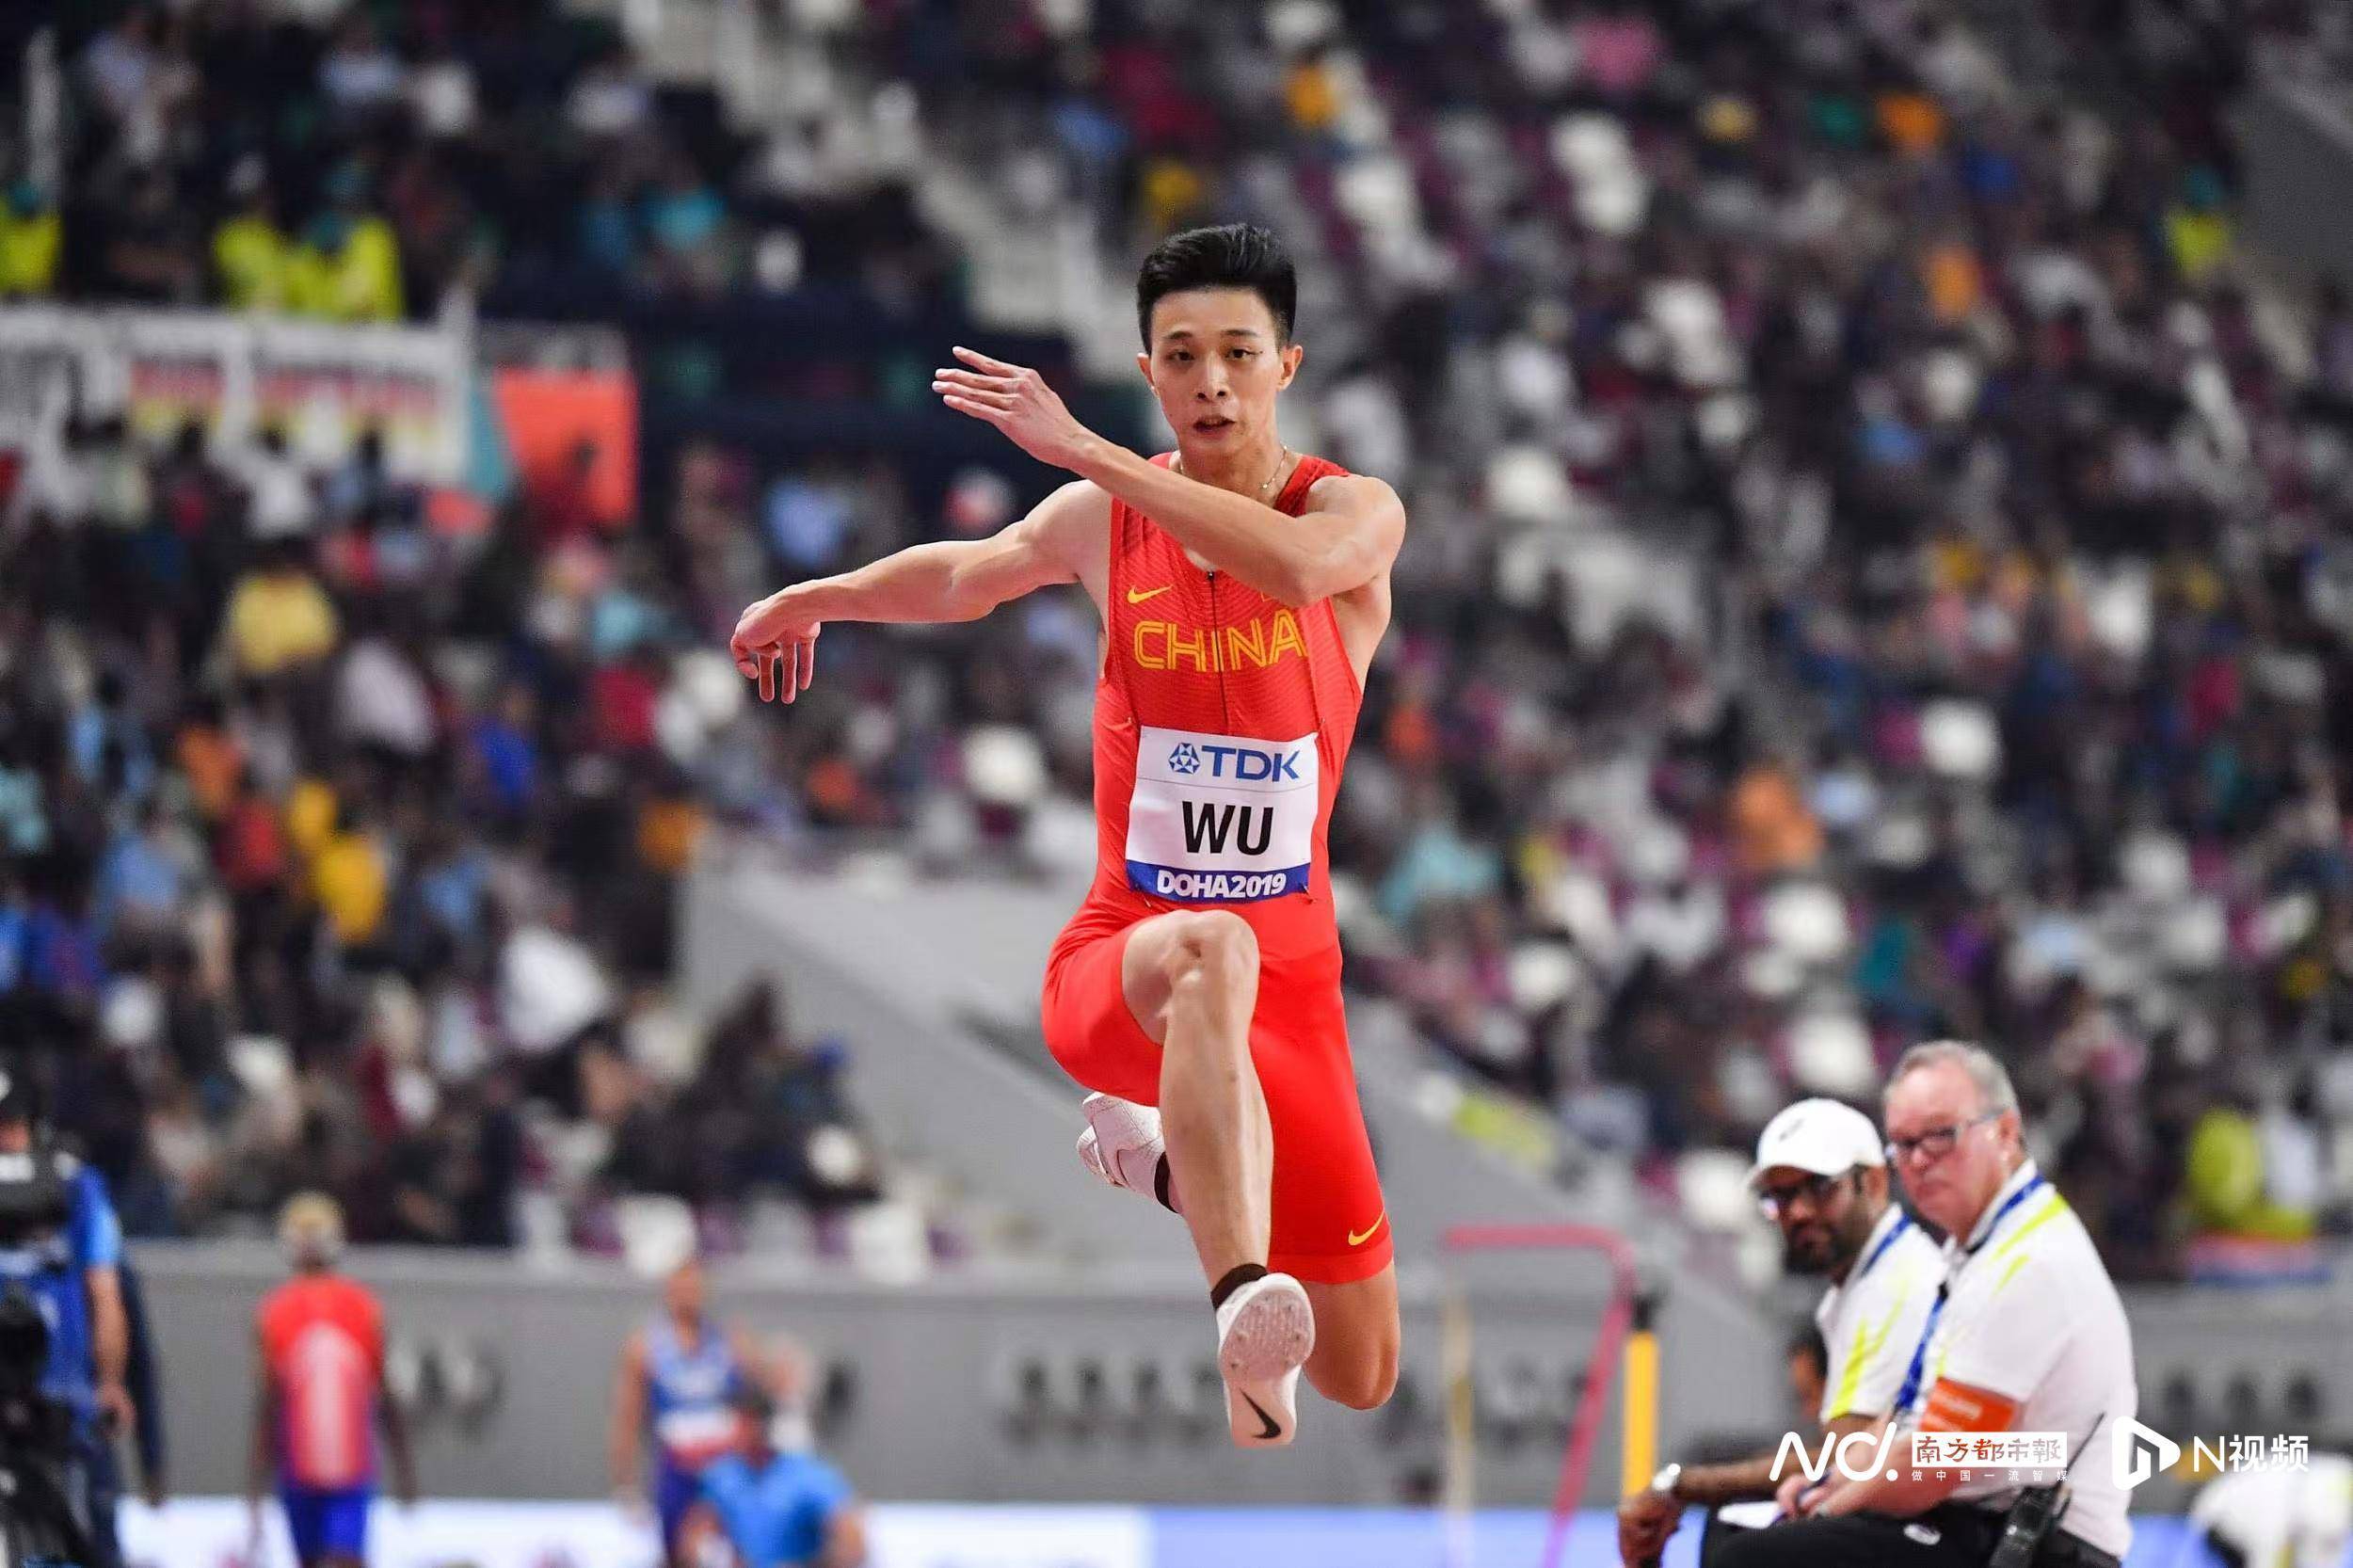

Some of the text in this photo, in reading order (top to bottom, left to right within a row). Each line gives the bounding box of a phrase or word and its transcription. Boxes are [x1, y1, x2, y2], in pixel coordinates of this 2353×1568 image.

[1134, 609, 1308, 672] CHINA
[1201, 745, 1300, 782] TDK
[1182, 801, 1273, 856] WU
[1157, 871, 1287, 898] DOHA2019
